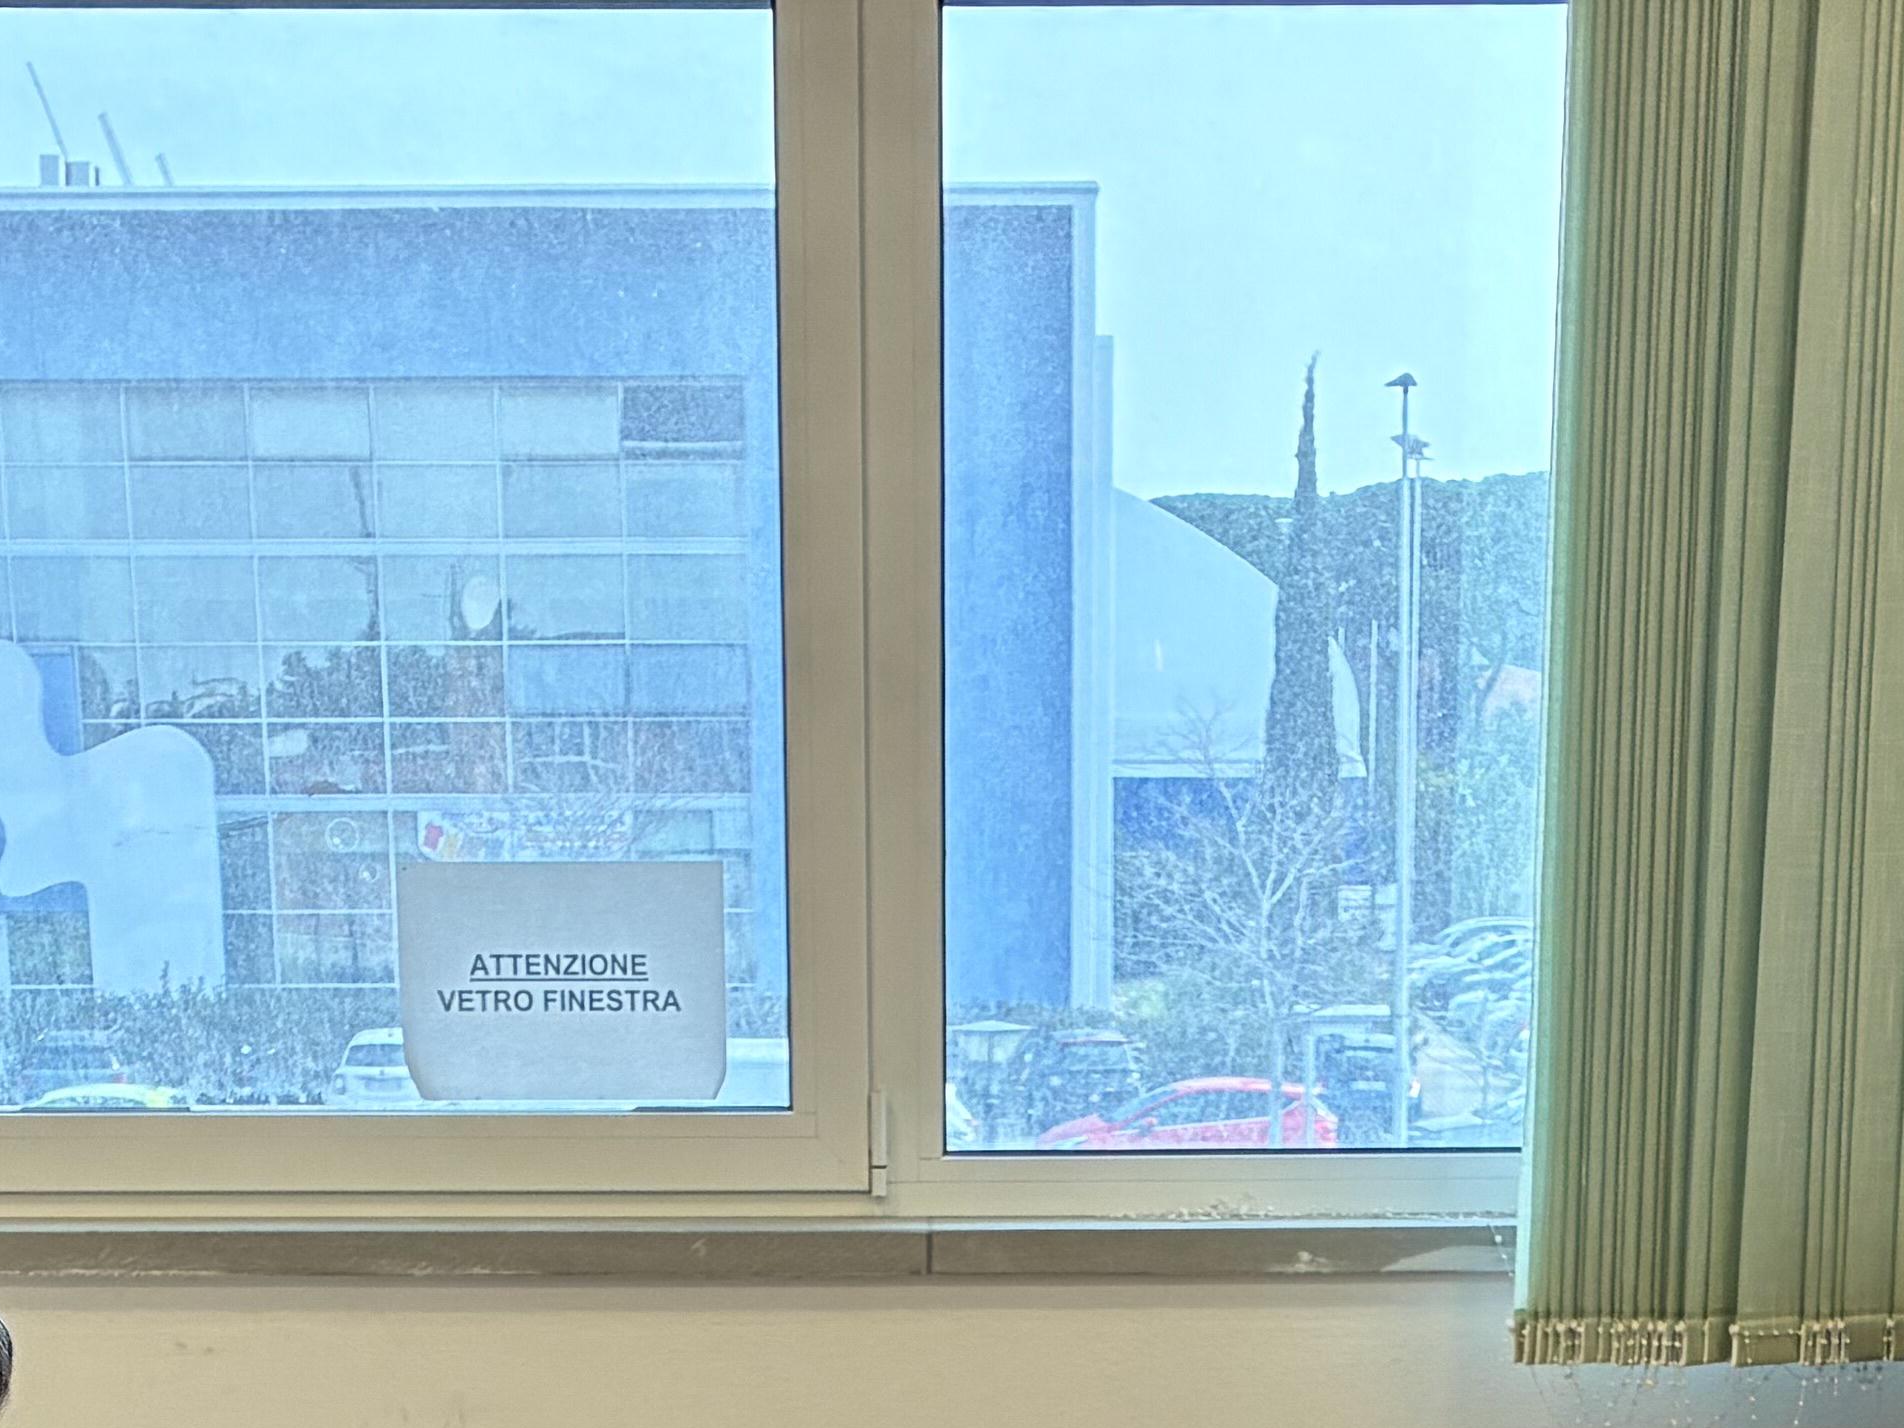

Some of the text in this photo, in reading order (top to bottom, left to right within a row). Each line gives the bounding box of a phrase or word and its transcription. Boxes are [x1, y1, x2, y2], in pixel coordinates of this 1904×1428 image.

[470, 953, 648, 977] ATTENZIONE
[437, 989, 682, 1012] VETRO FINESTRA
